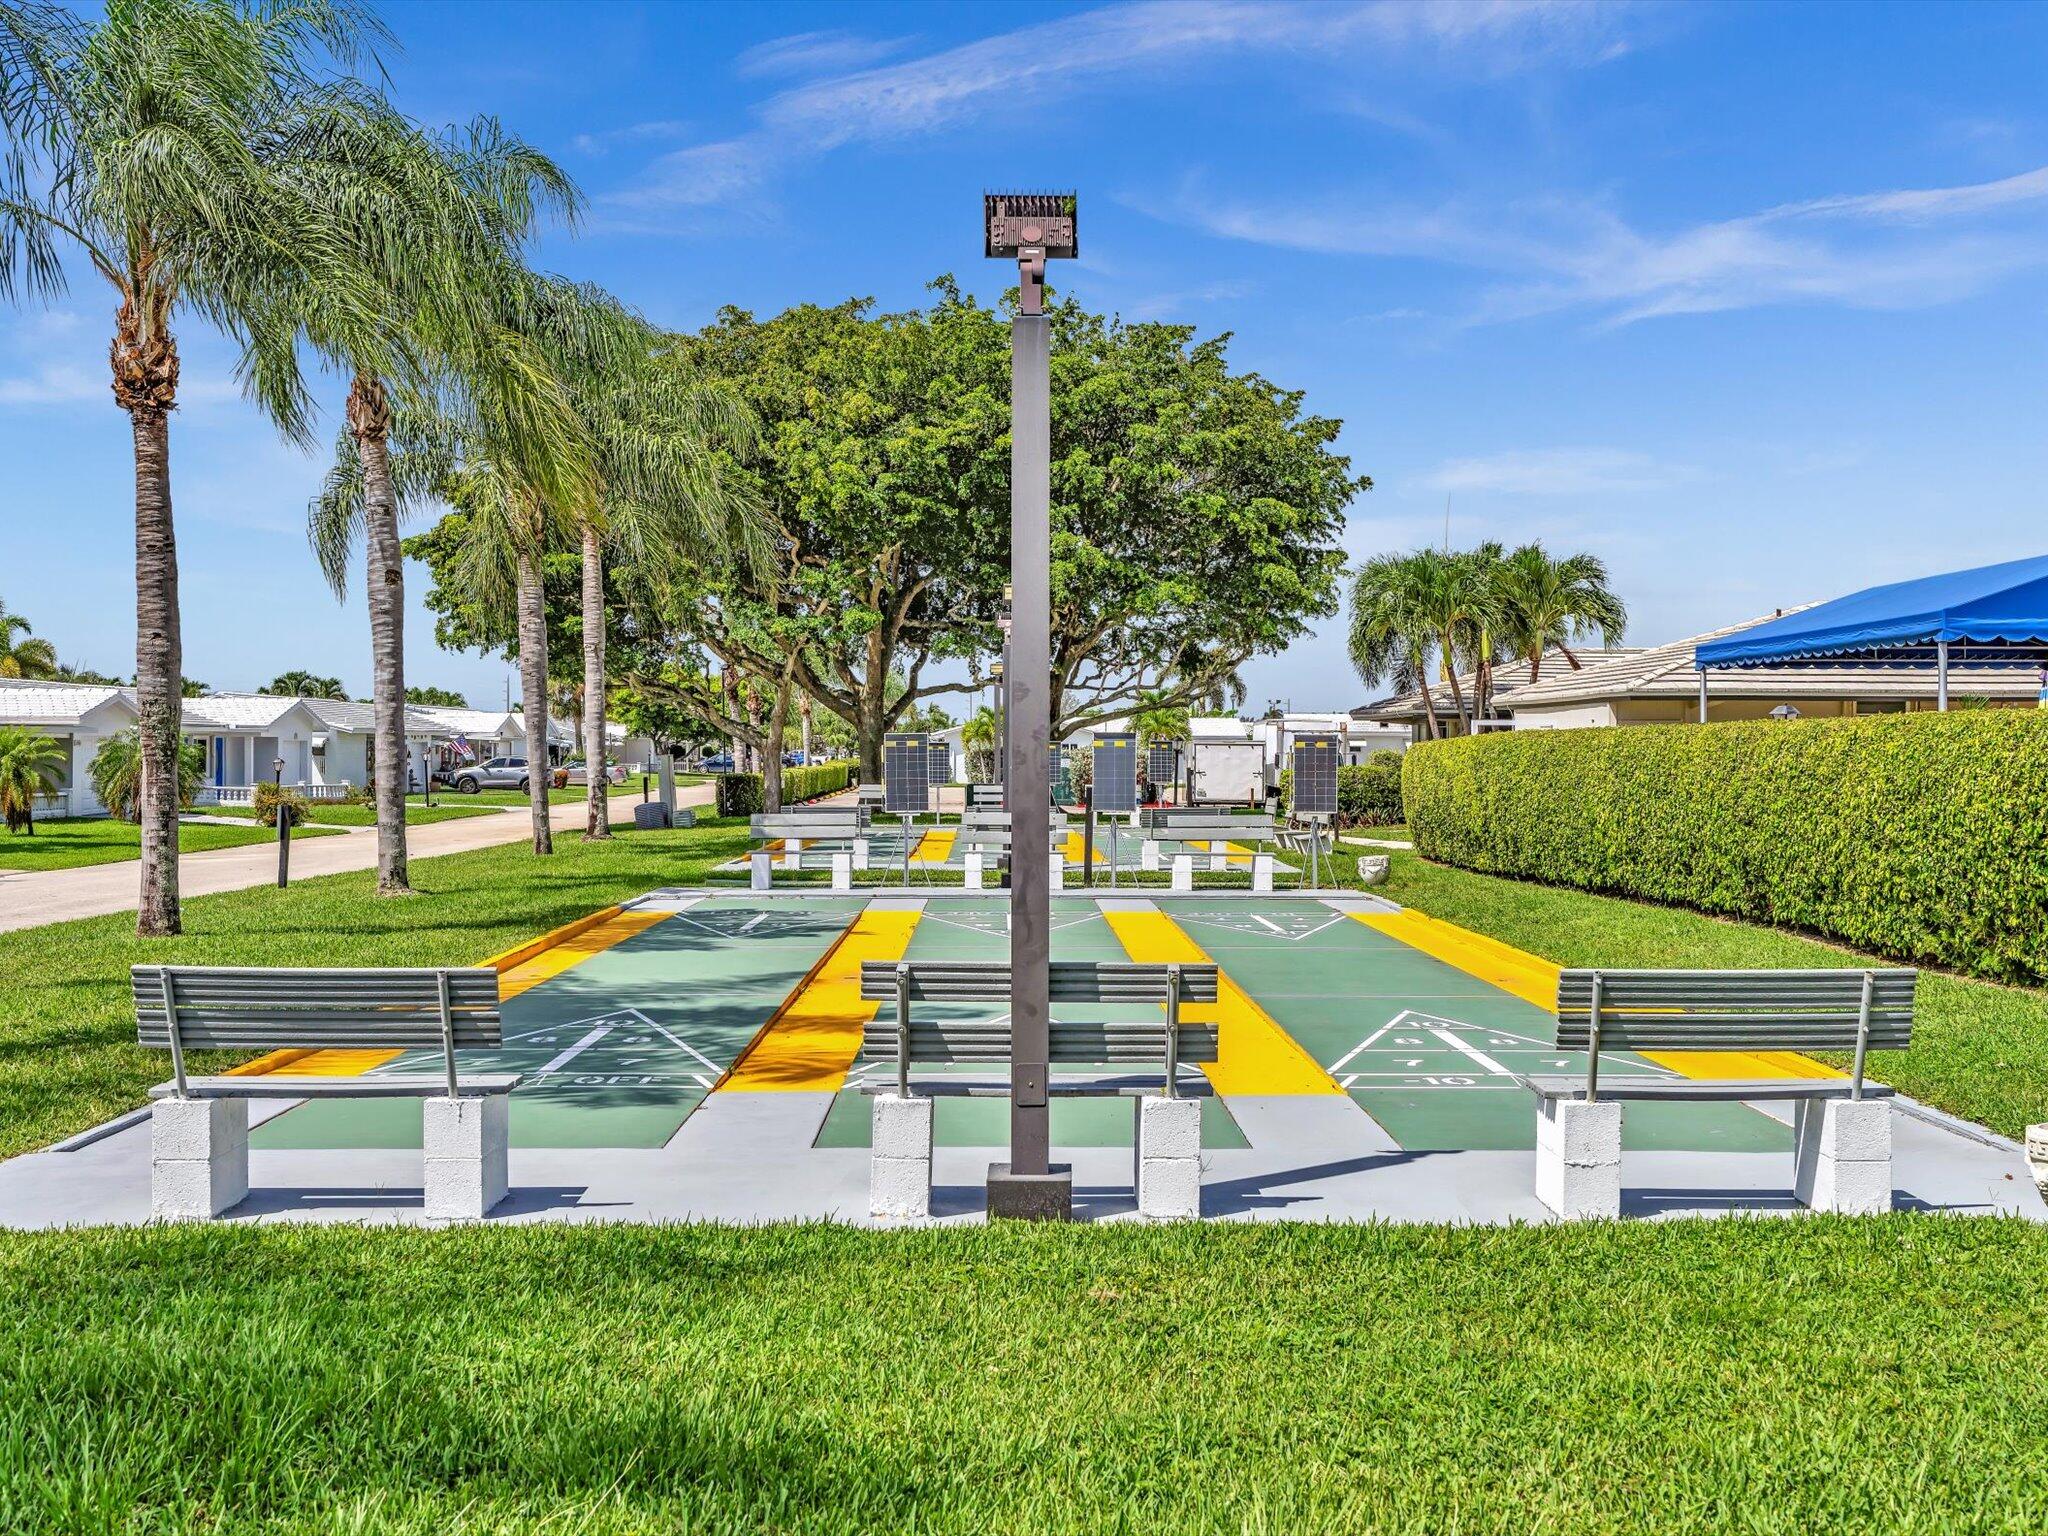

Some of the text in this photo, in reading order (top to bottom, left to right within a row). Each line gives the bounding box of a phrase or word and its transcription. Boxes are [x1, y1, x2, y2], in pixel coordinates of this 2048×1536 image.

[616, 1058, 649, 1066] 7
[1391, 1059, 1424, 1067] 7
[573, 1075, 671, 1084] OFF
